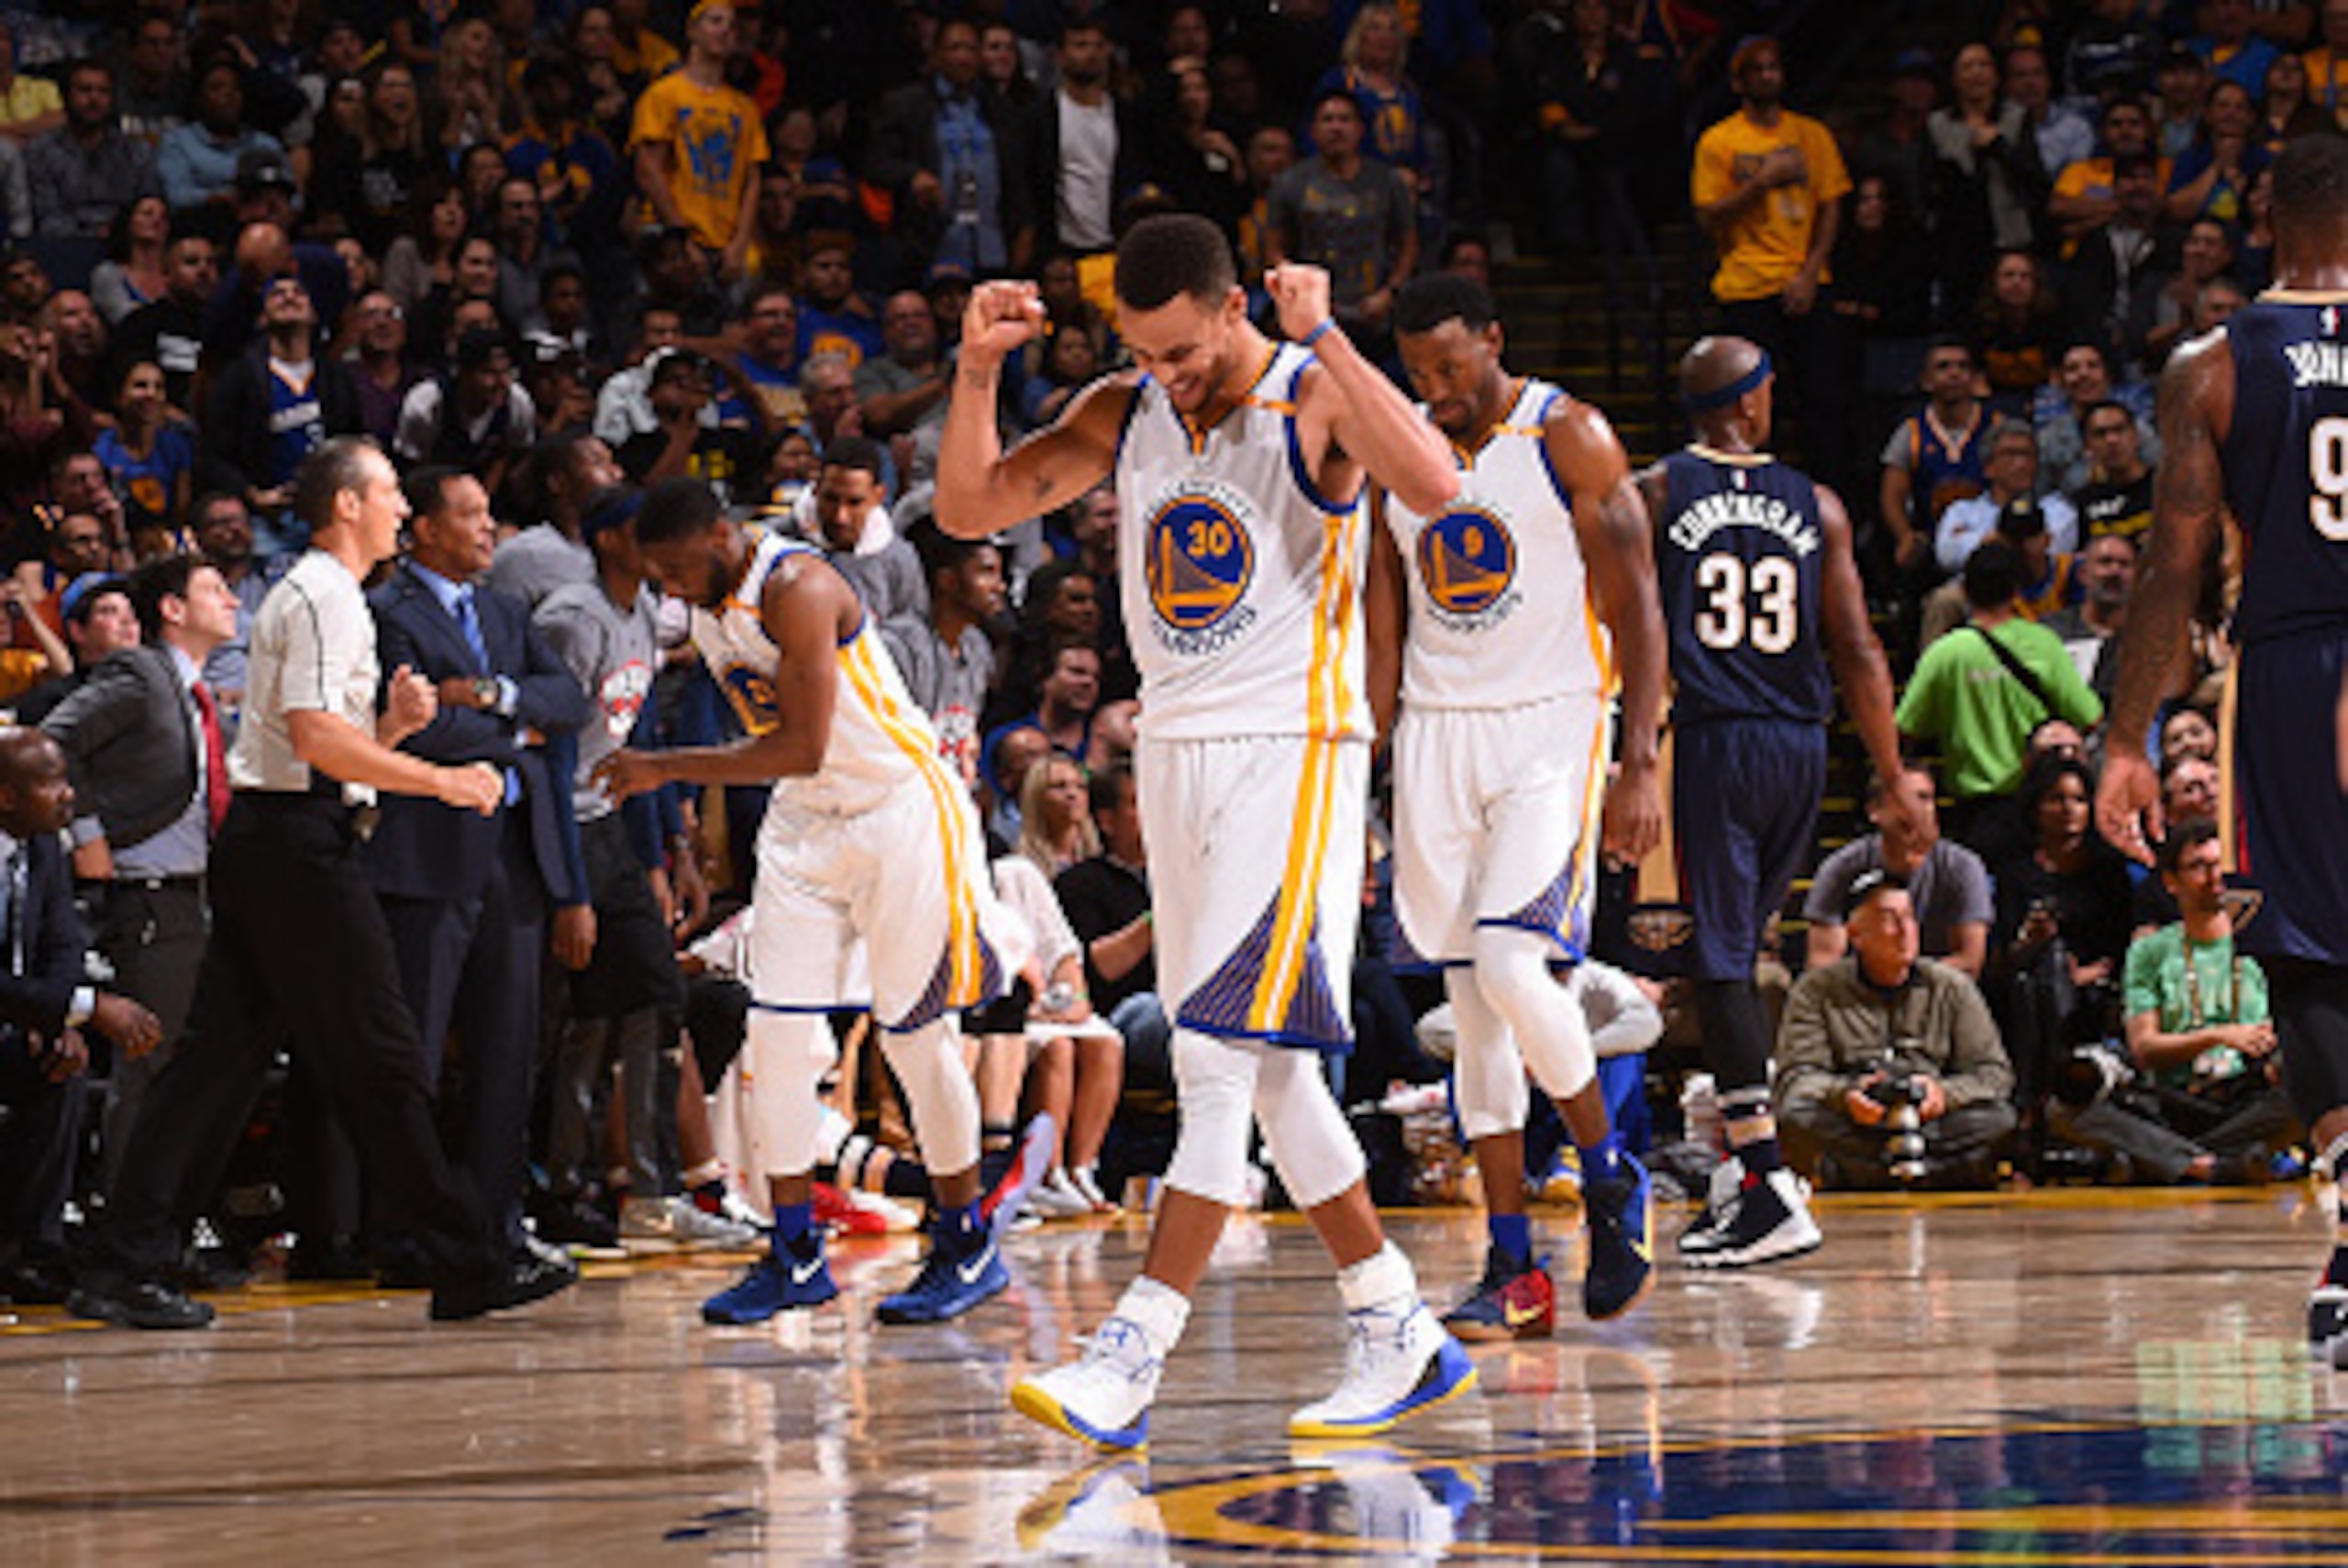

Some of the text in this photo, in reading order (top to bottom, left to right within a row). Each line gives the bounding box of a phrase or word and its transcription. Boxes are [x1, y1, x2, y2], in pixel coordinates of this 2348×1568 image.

[2309, 417, 2348, 541] 9
[1187, 520, 1233, 558] 30
[1463, 525, 1485, 559] 9
[1695, 553, 1799, 653] 33
